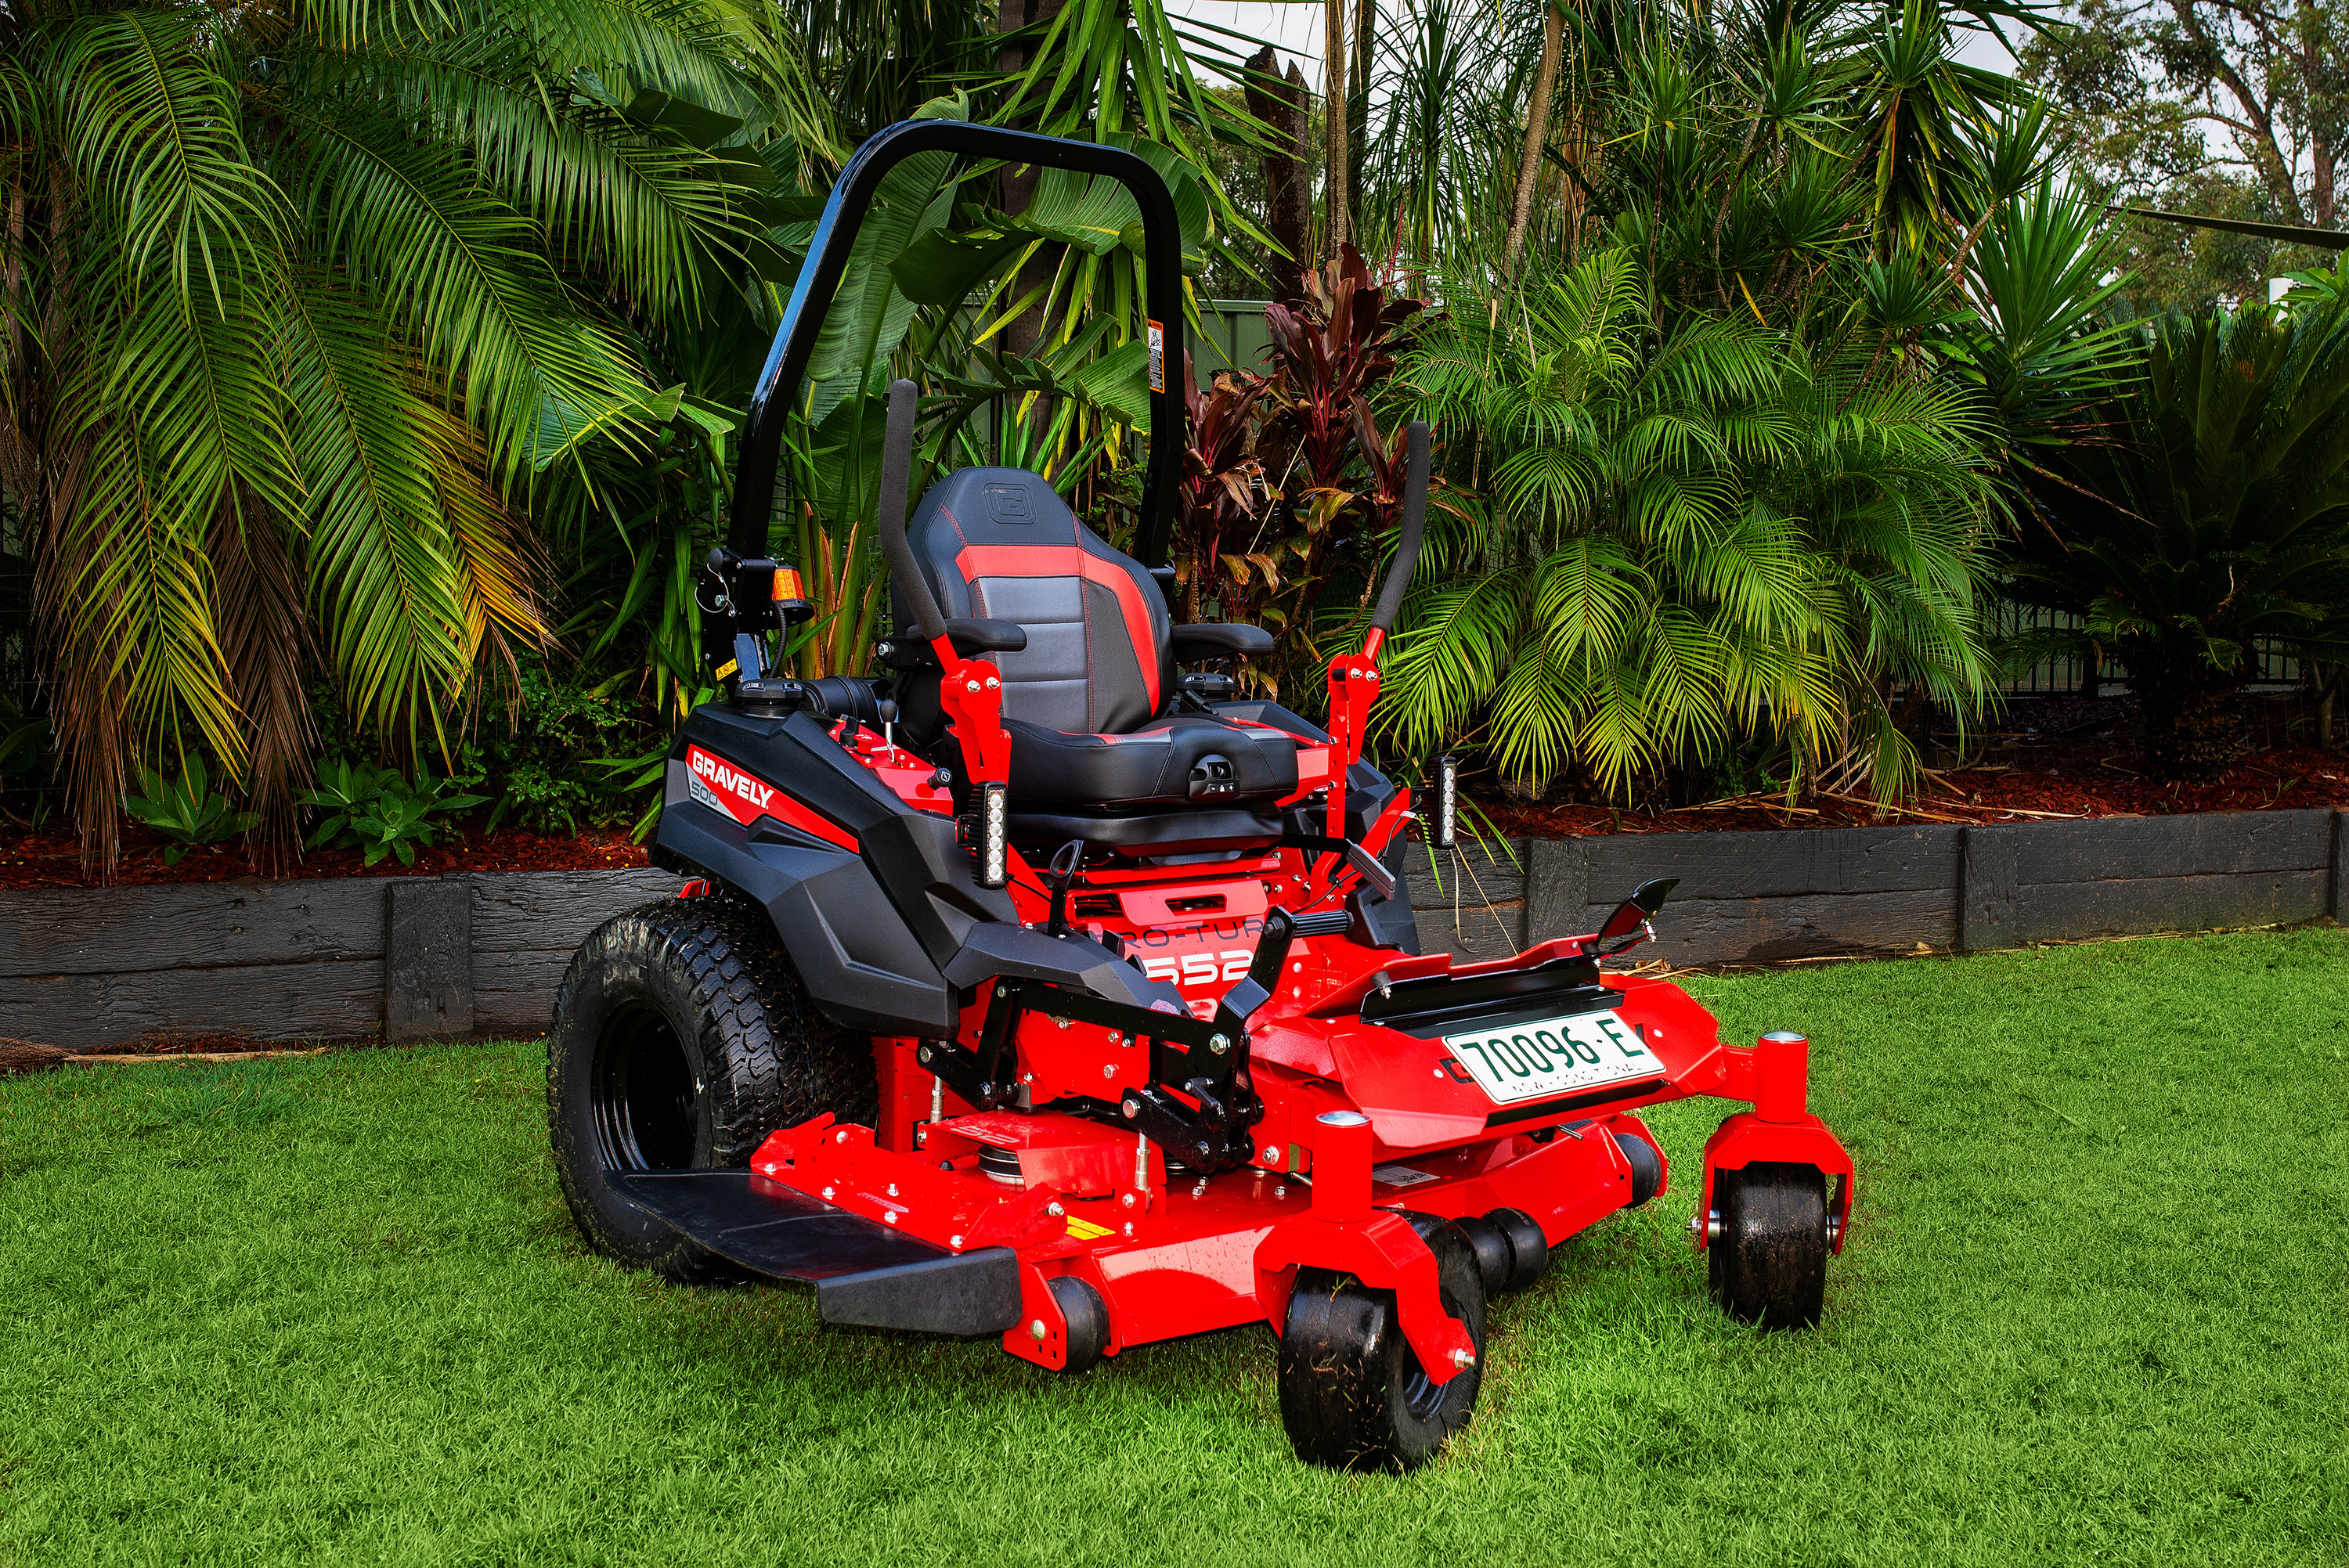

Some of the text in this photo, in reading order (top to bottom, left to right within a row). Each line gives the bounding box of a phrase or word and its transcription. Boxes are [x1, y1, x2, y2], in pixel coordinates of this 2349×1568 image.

[691, 780, 718, 806] 500
[693, 750, 774, 809] GRAVELY
[1142, 950, 1254, 986] 552
[1511, 1080, 1544, 1094] NSW
[1557, 1062, 1643, 1085] CONDITIONAL
